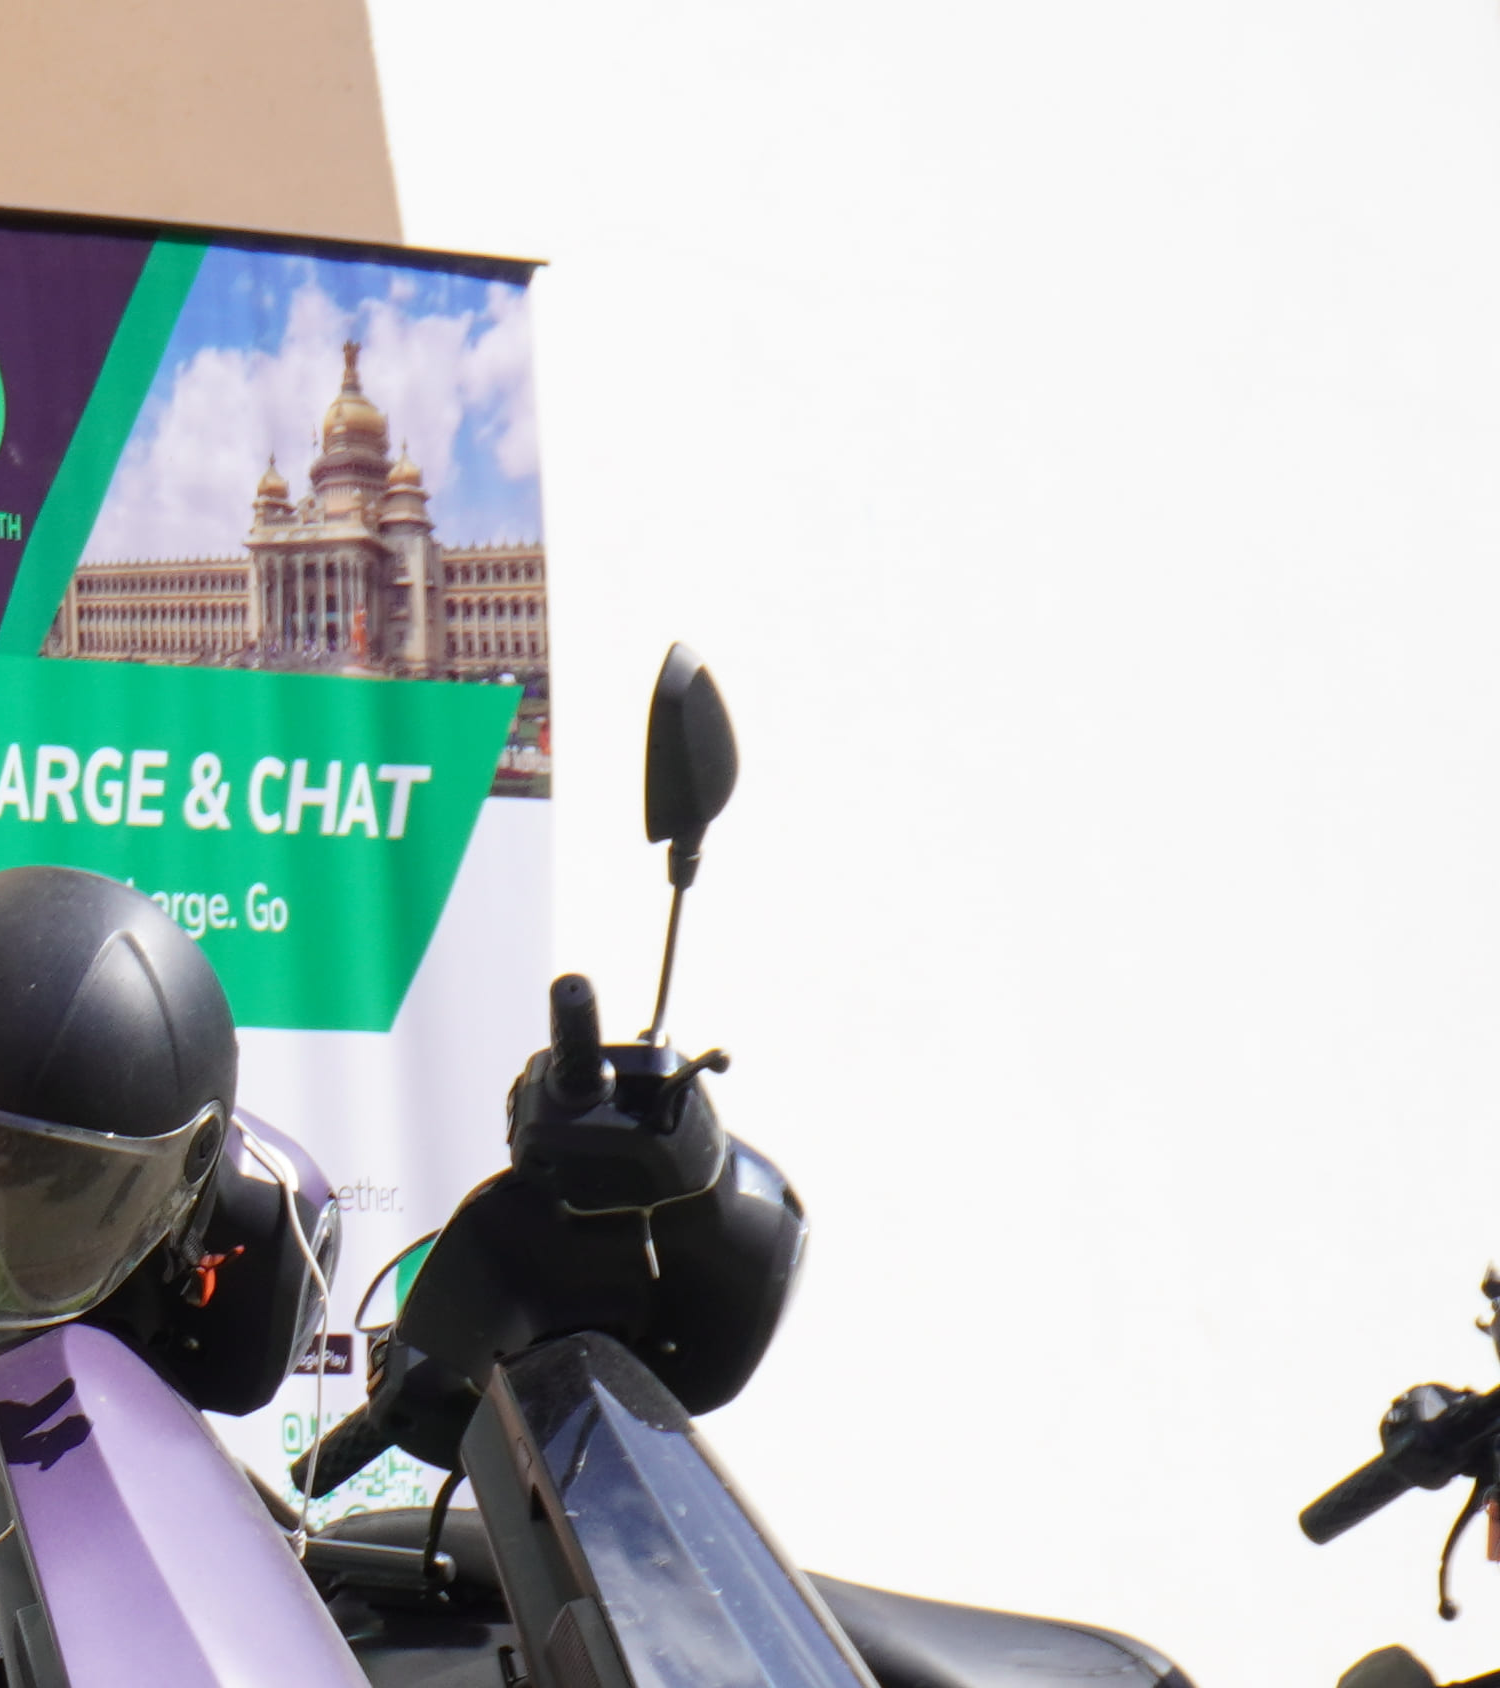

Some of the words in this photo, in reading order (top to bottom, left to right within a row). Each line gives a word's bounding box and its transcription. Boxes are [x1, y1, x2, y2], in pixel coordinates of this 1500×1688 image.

[182, 752, 232, 830] &
[248, 756, 433, 841] CHAT
[245, 882, 288, 932] Go
[337, 1176, 404, 1212] ether.
